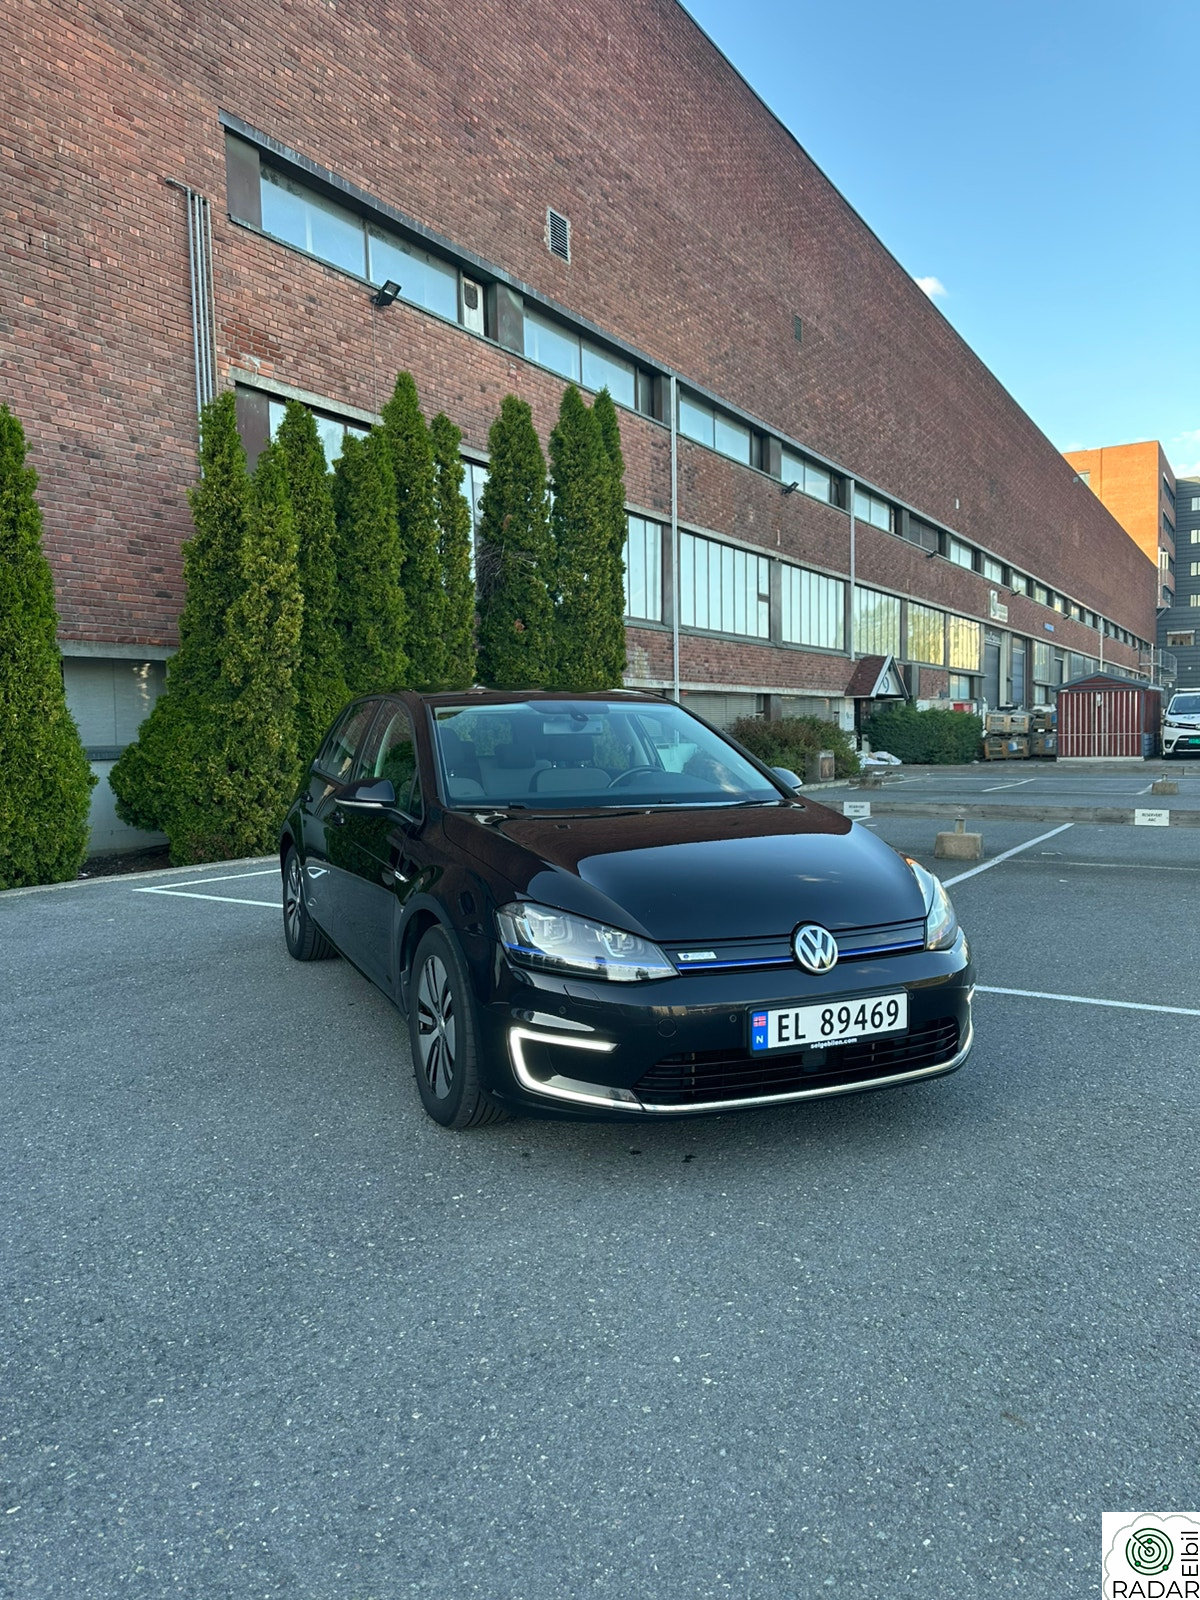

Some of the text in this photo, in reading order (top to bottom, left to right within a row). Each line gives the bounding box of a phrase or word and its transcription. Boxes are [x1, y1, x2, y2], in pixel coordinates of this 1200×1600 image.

[796, 926, 837, 971] VW
[755, 1035, 764, 1044] N
[777, 999, 899, 1042] EL 89469
